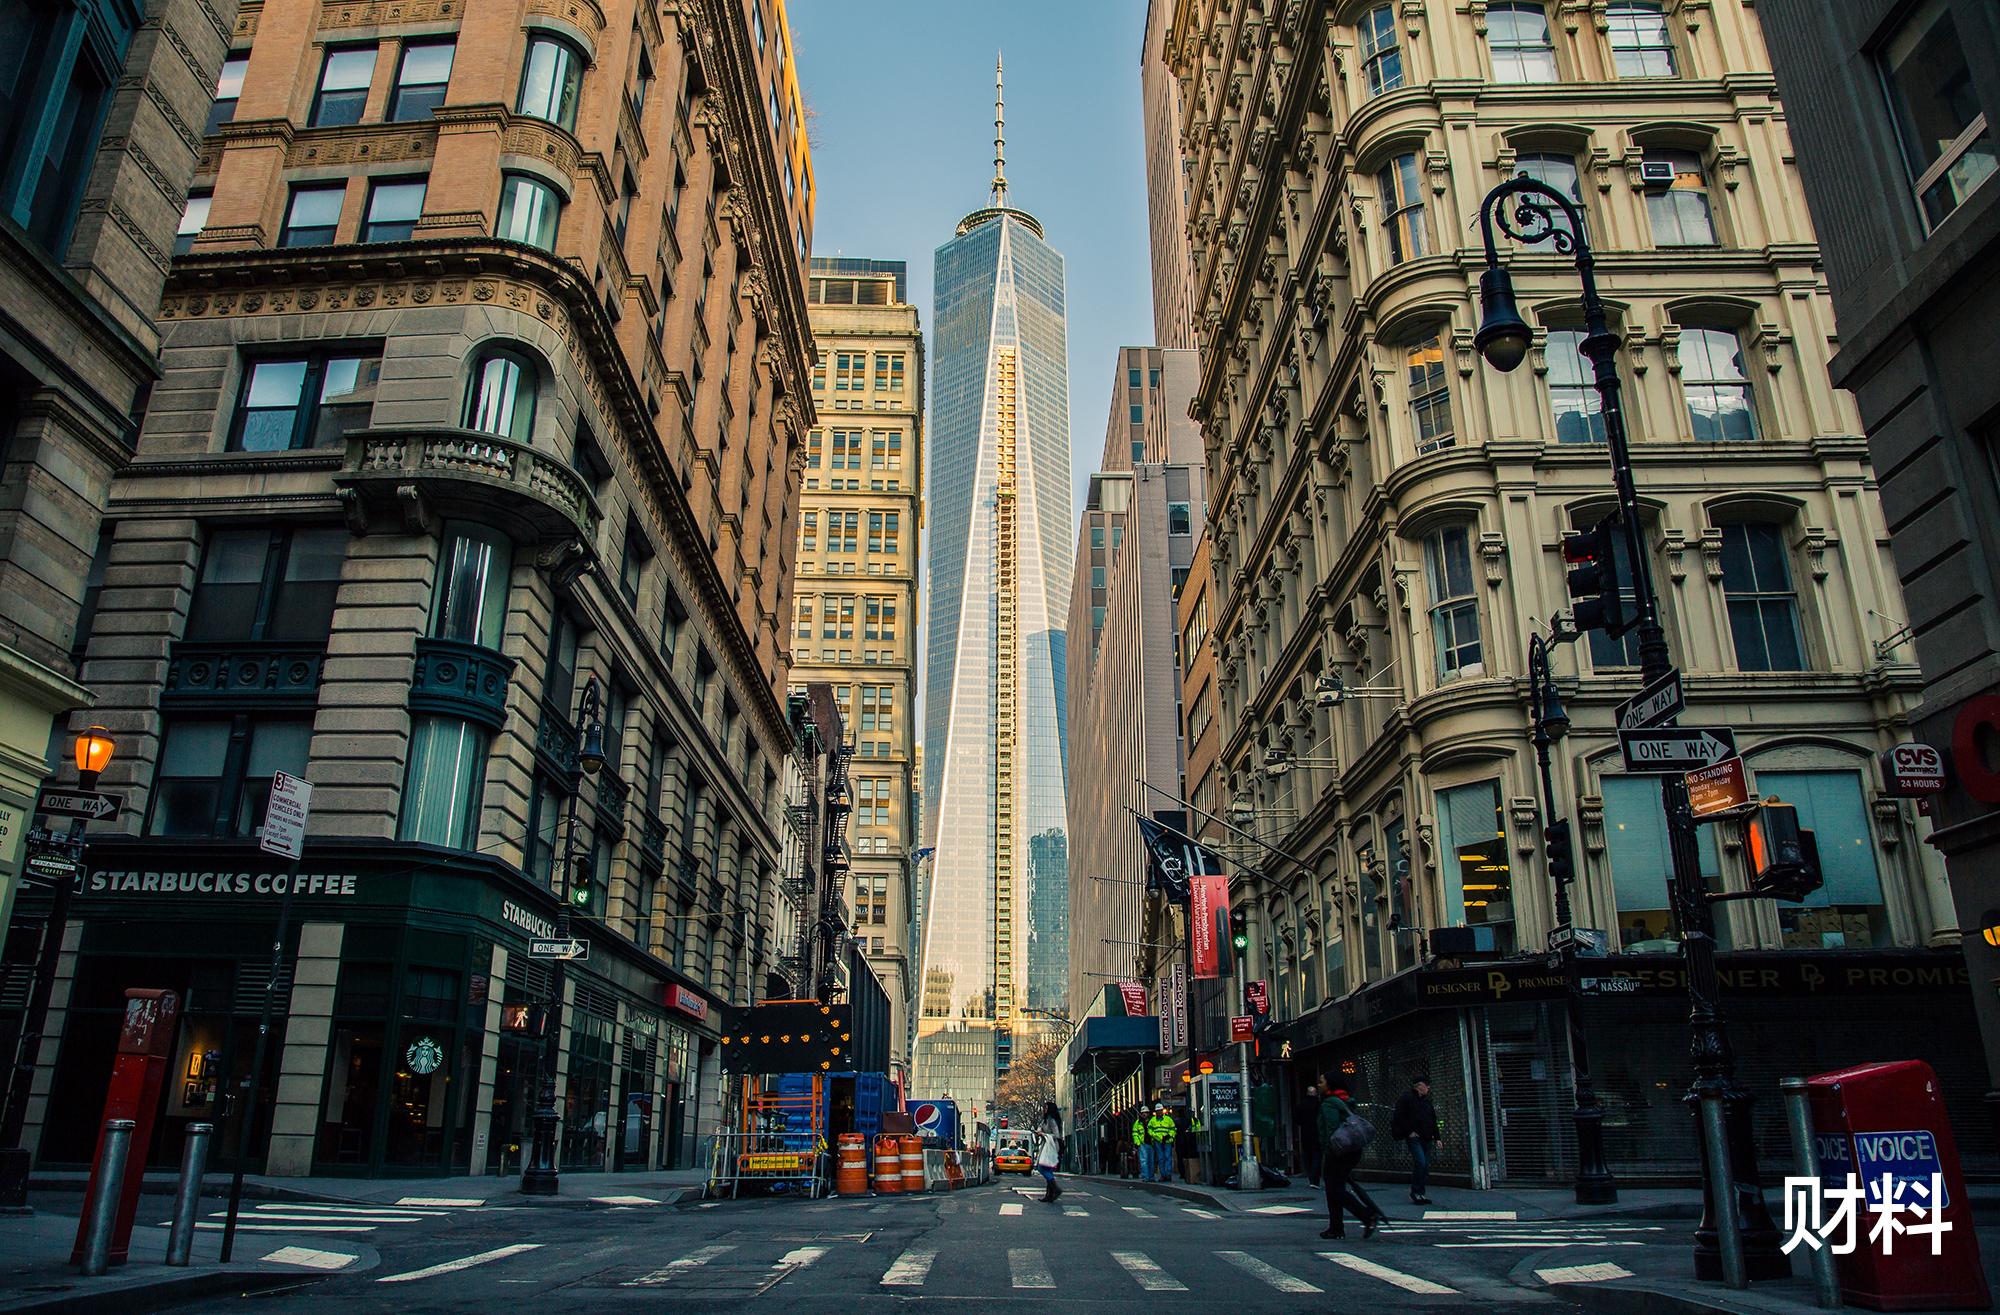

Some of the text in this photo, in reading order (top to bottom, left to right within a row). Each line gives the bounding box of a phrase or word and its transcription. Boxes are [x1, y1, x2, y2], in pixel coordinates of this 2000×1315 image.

[1626, 686, 1673, 729] ONE WAY
[1639, 742, 1718, 758] ONE WAY
[1894, 748, 1938, 766] CVS
[1688, 764, 1733, 784] NO STANDING
[1898, 766, 1938, 774] pharmacy
[276, 774, 284, 790] 3
[1690, 783, 1710, 794] Monday
[1714, 776, 1731, 786] Friday
[1901, 780, 1940, 788] 24 HOURS
[48, 796, 108, 812] ONE WAY
[272, 802, 304, 818] VEHICLES ONLY
[274, 794, 302, 810] COMMERCIAL
[90, 871, 358, 895] STARBUCKS COFFEE
[502, 900, 552, 939] STARBUCKS
[1194, 903, 1202, 938] Manhattan
[538, 944, 554, 952] ONE
[1196, 938, 1204, 964] Hospital
[1427, 982, 1482, 995] DESIGNER
[1518, 975, 1566, 989] PROMISE
[1600, 982, 1635, 992] NASSAU
[1611, 970, 1781, 988] ESINER
[1846, 967, 1969, 986] PROMIS
[1162, 1020, 1170, 1053] Lucille
[1816, 1137, 1849, 1161] OICE
[1862, 1135, 1933, 1162] VOICE
